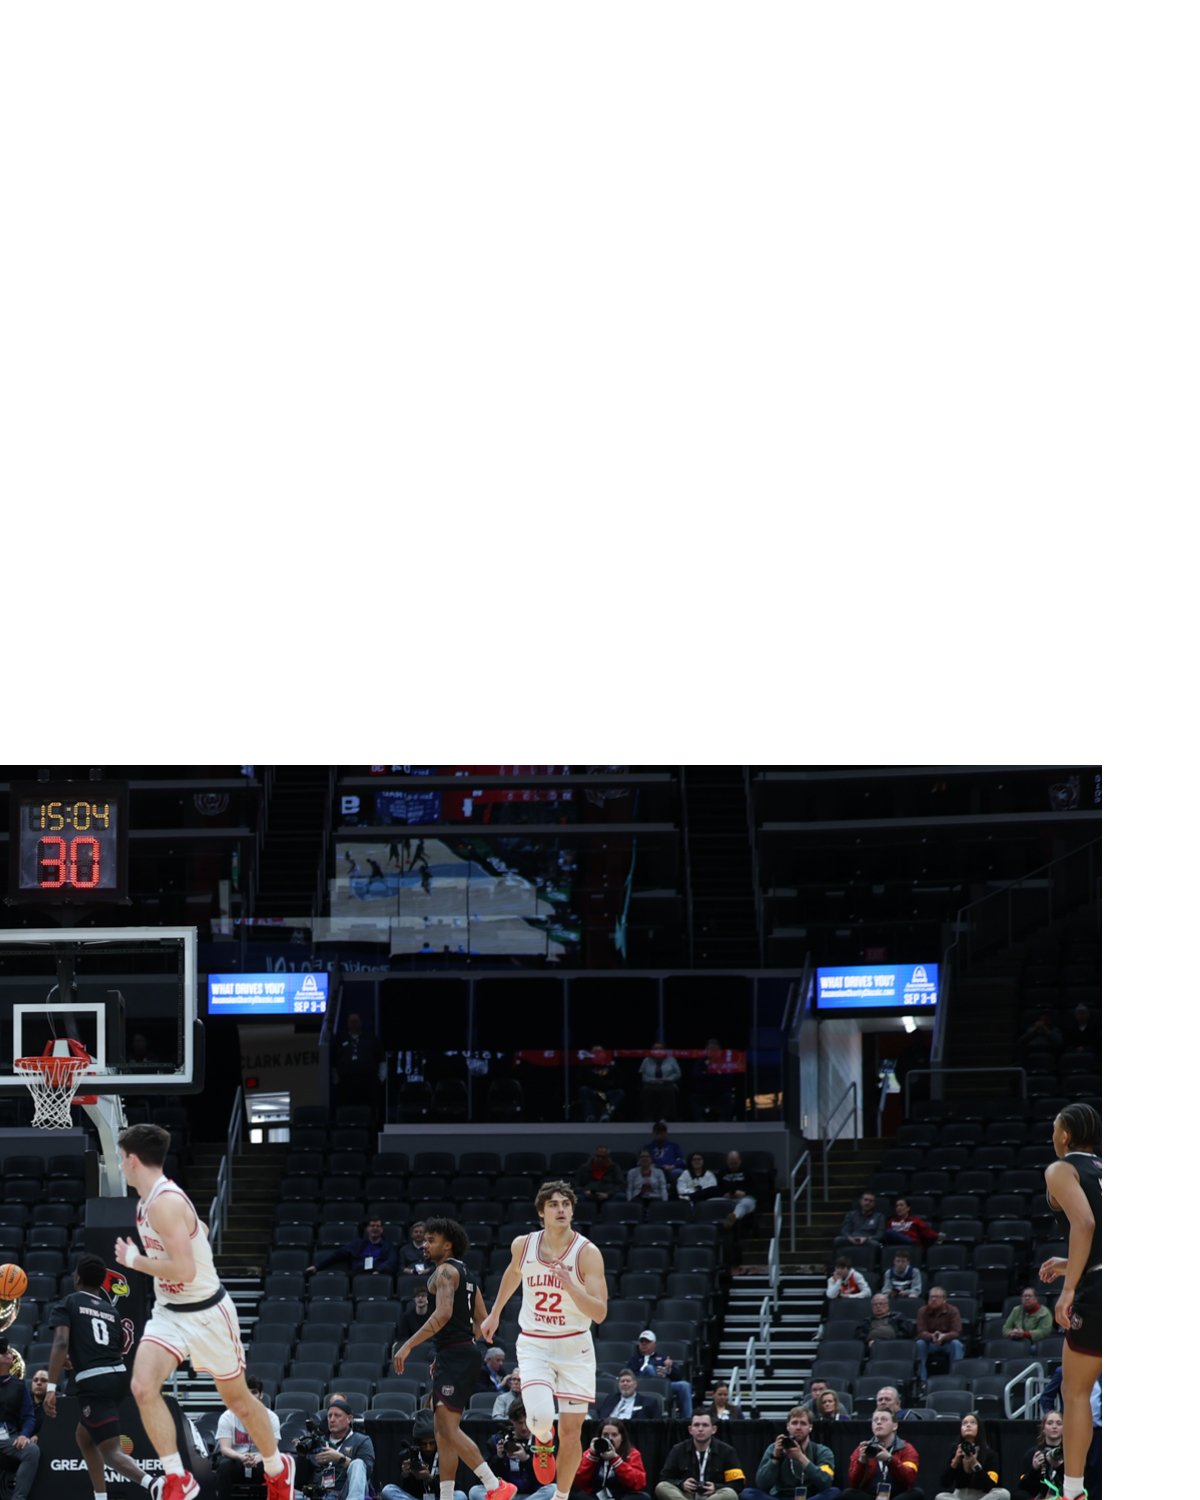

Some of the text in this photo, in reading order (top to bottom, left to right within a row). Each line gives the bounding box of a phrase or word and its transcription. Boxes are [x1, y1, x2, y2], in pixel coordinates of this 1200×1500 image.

[40, 801, 110, 831] 15:04
[40, 836, 100, 888] 30
[211, 982, 285, 995] WHAT DRIVES YOU?
[820, 974, 895, 989] WHAT DRIVES YOU?
[240, 1051, 319, 1069] CLARK AVEN
[527, 1274, 564, 1290] ILLINO
[535, 1291, 562, 1313] 22
[534, 1313, 566, 1326] STATE
[91, 1317, 109, 1346] 0
[50, 1459, 89, 1471] GREA
